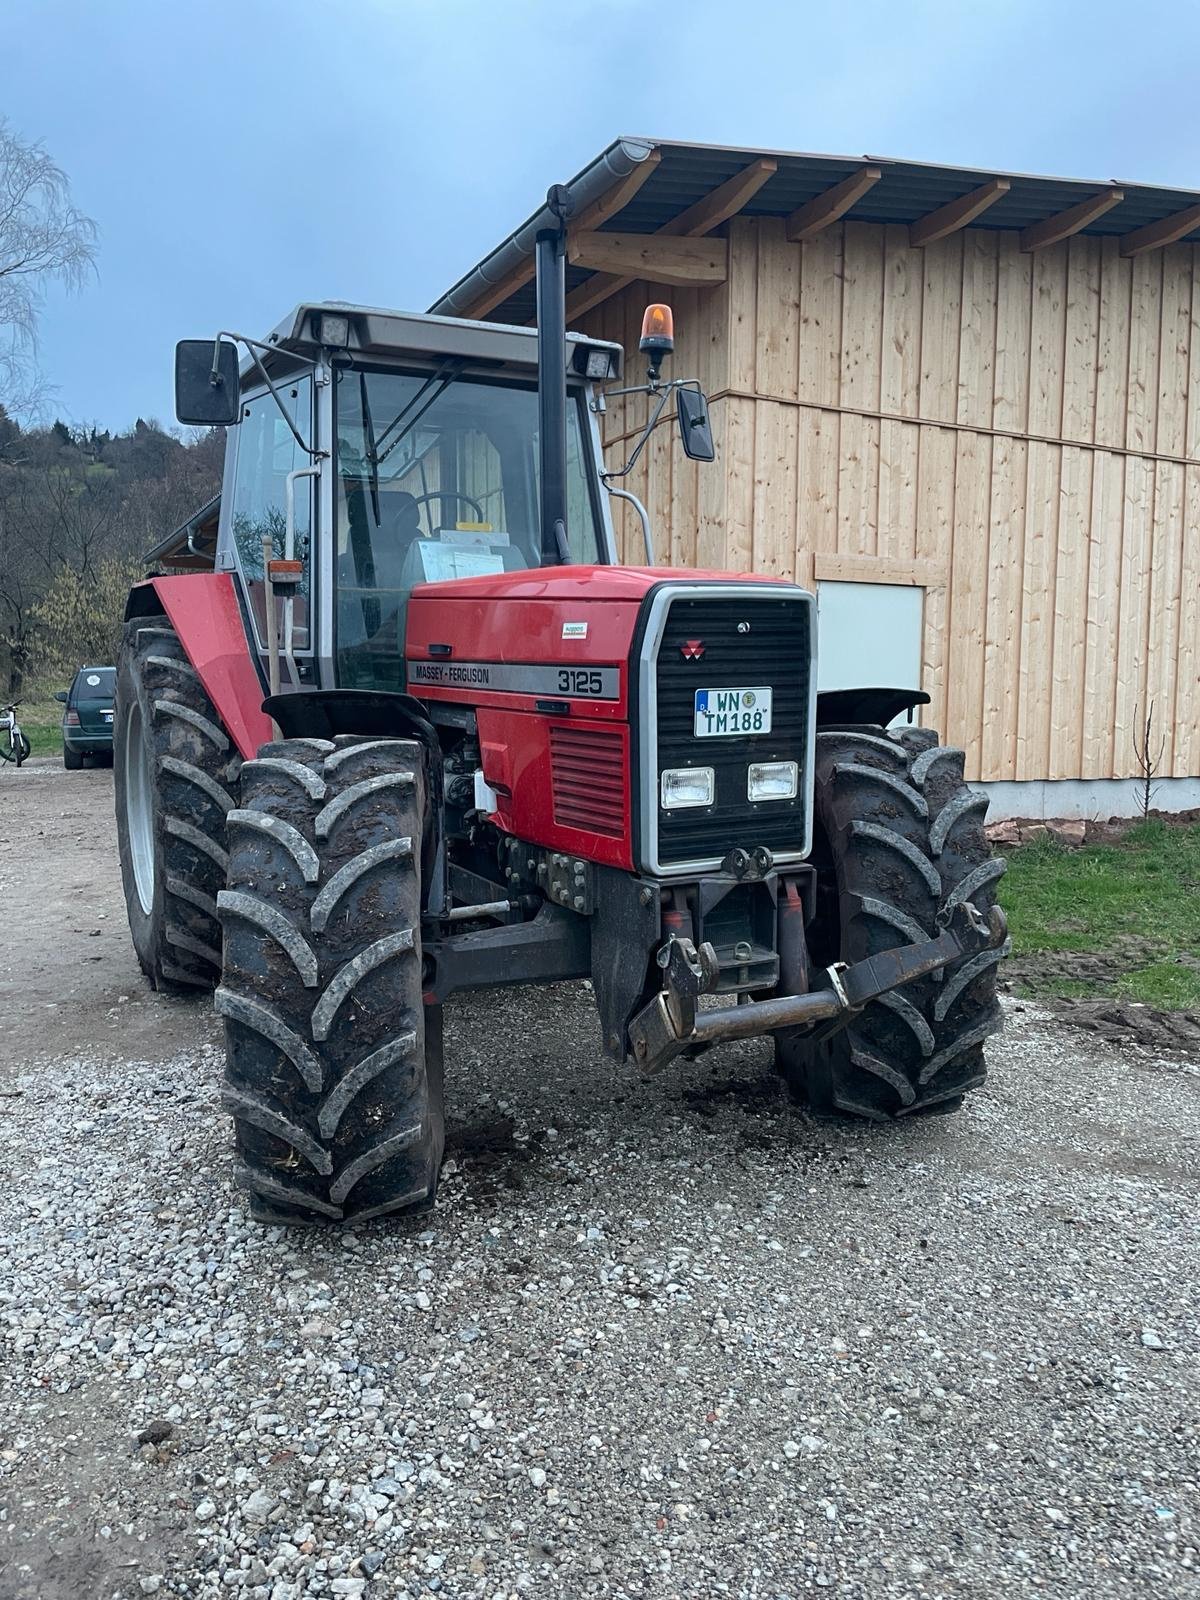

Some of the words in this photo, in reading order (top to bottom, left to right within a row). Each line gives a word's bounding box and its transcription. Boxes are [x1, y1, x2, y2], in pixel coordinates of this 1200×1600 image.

[558, 670, 603, 694] 3125
[717, 692, 740, 712] WN
[705, 711, 763, 733] TM188
